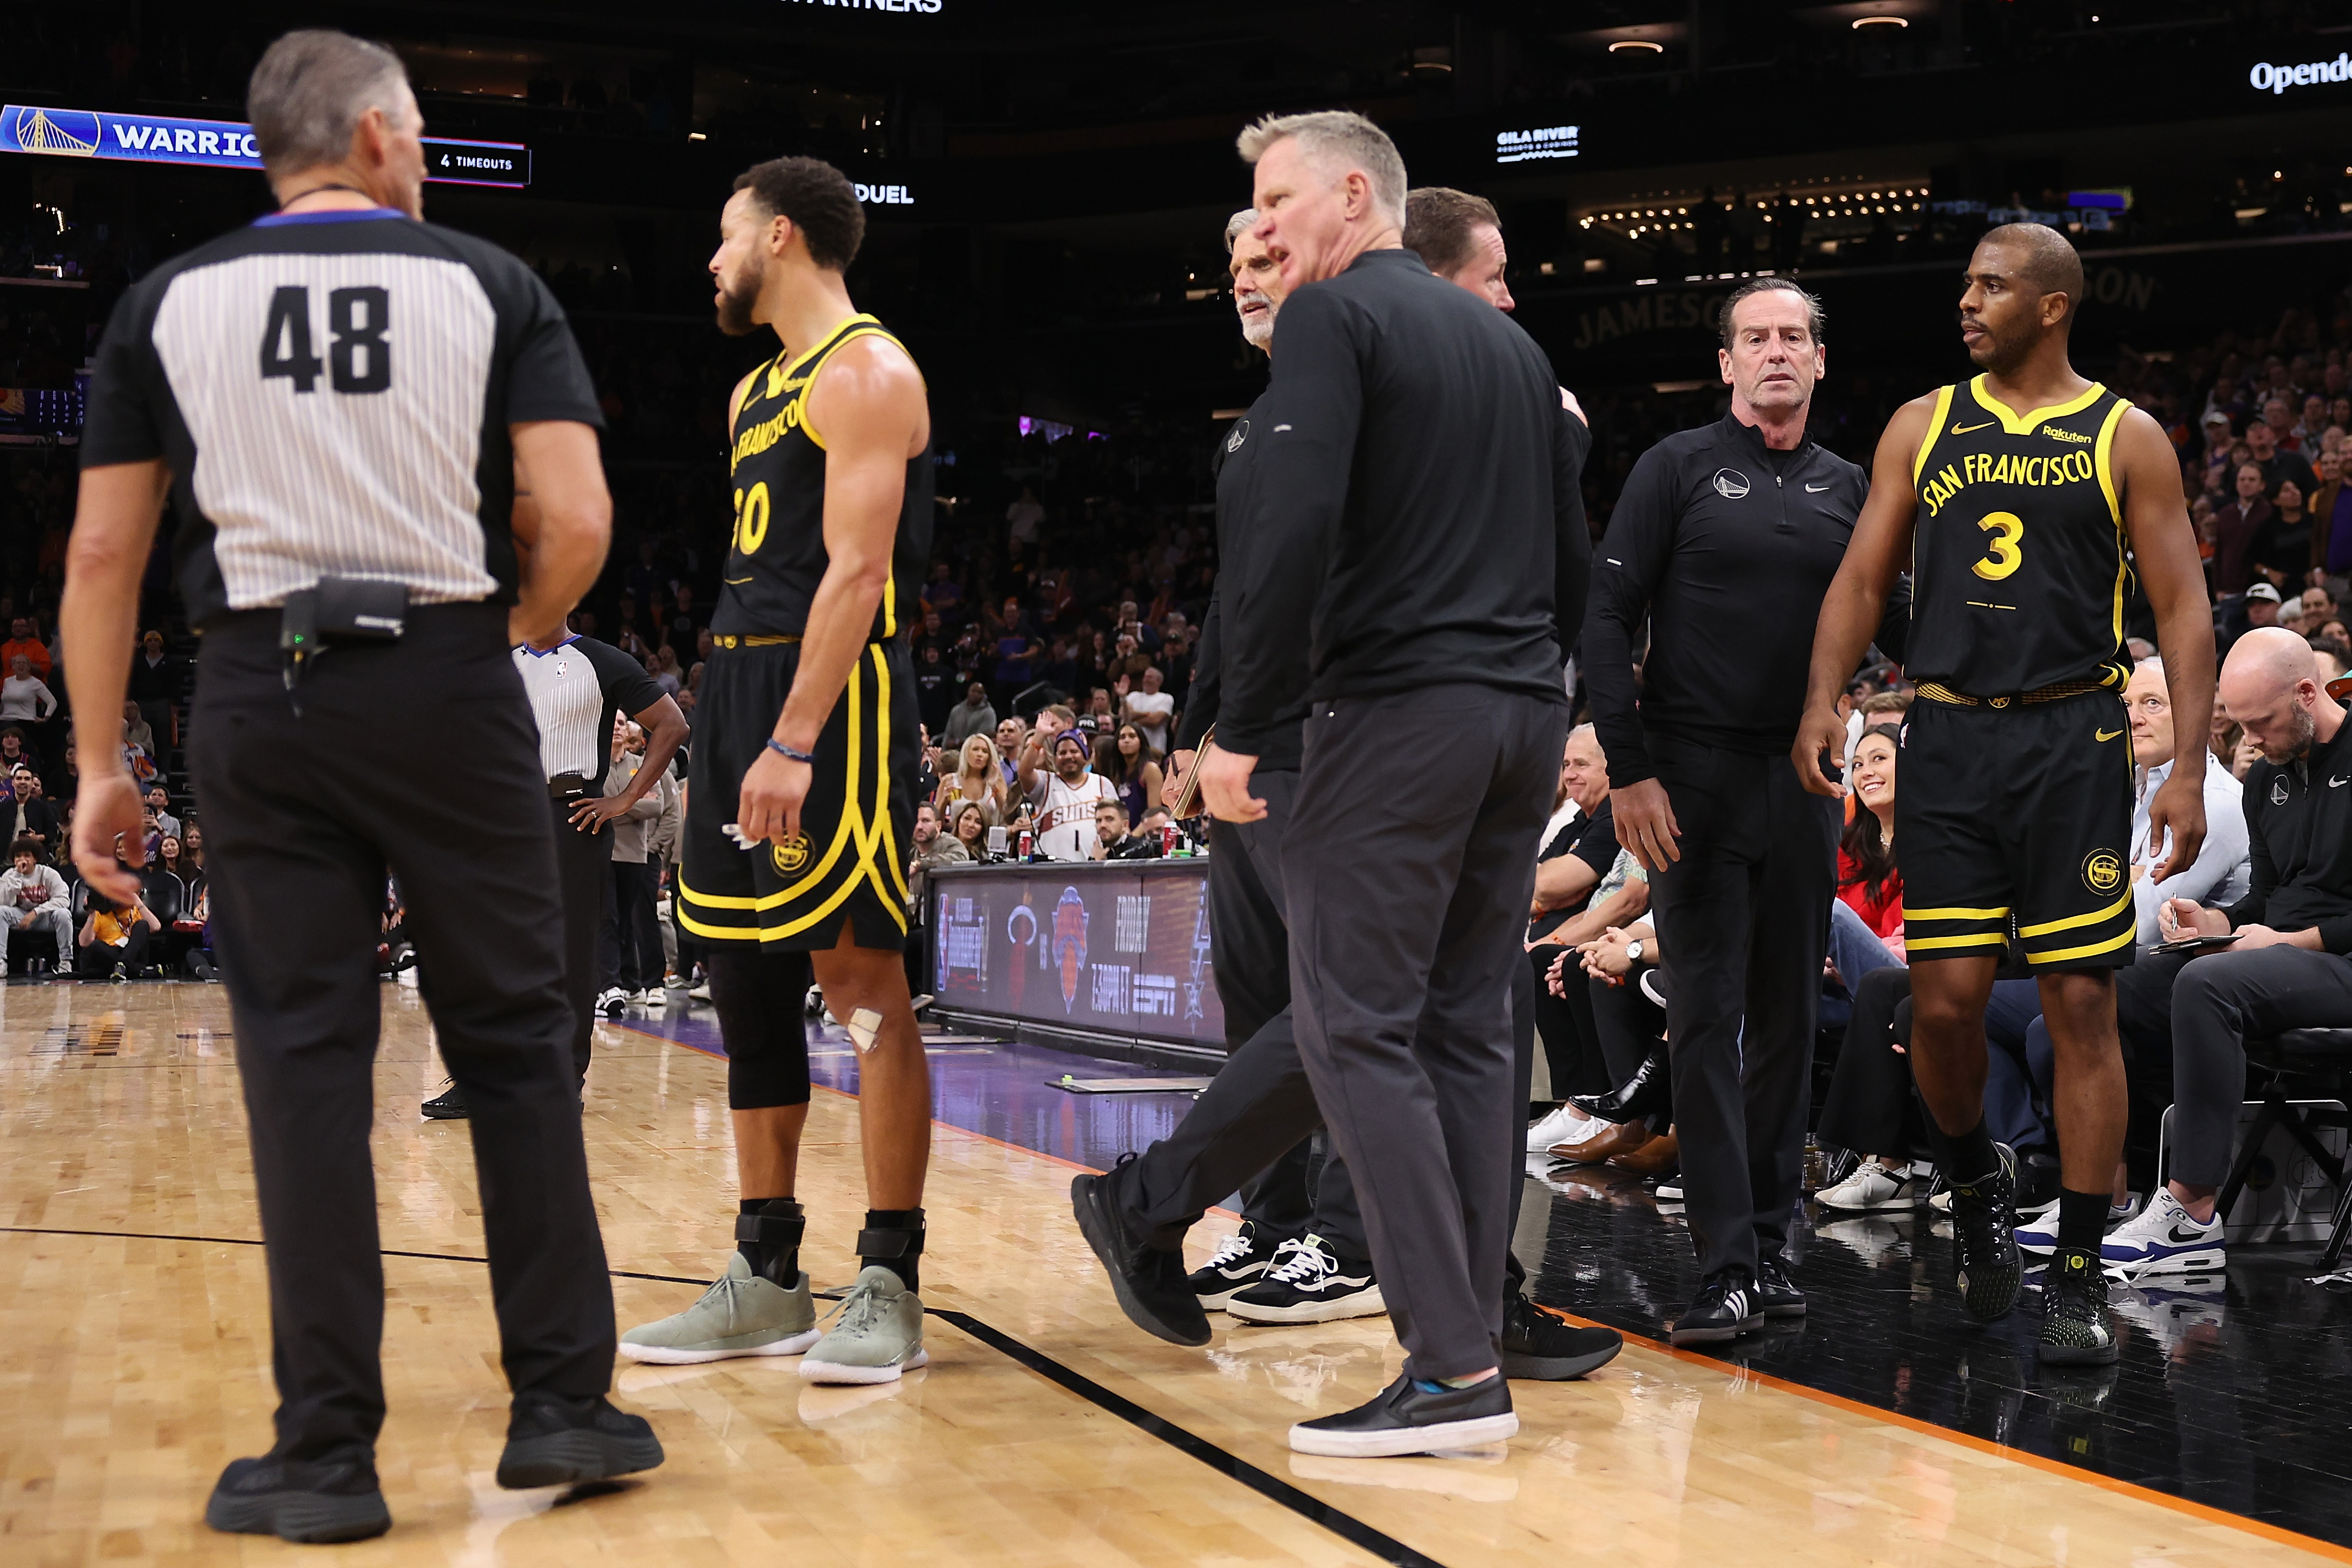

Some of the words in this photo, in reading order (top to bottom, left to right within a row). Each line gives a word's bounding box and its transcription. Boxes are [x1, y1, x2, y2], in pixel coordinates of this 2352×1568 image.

[441, 153, 450, 167] 4
[456, 156, 512, 170] TIMEOUTS
[261, 285, 391, 394] 48
[2043, 425, 2092, 443] Rakuten
[1923, 464, 1964, 517] SAN
[1963, 450, 2093, 486] FRANCISCO
[1971, 511, 2024, 581] 3
[1075, 829, 1080, 851] 1
[1115, 896, 1151, 953] FRIDAY
[1132, 973, 1176, 1016] ESPN
